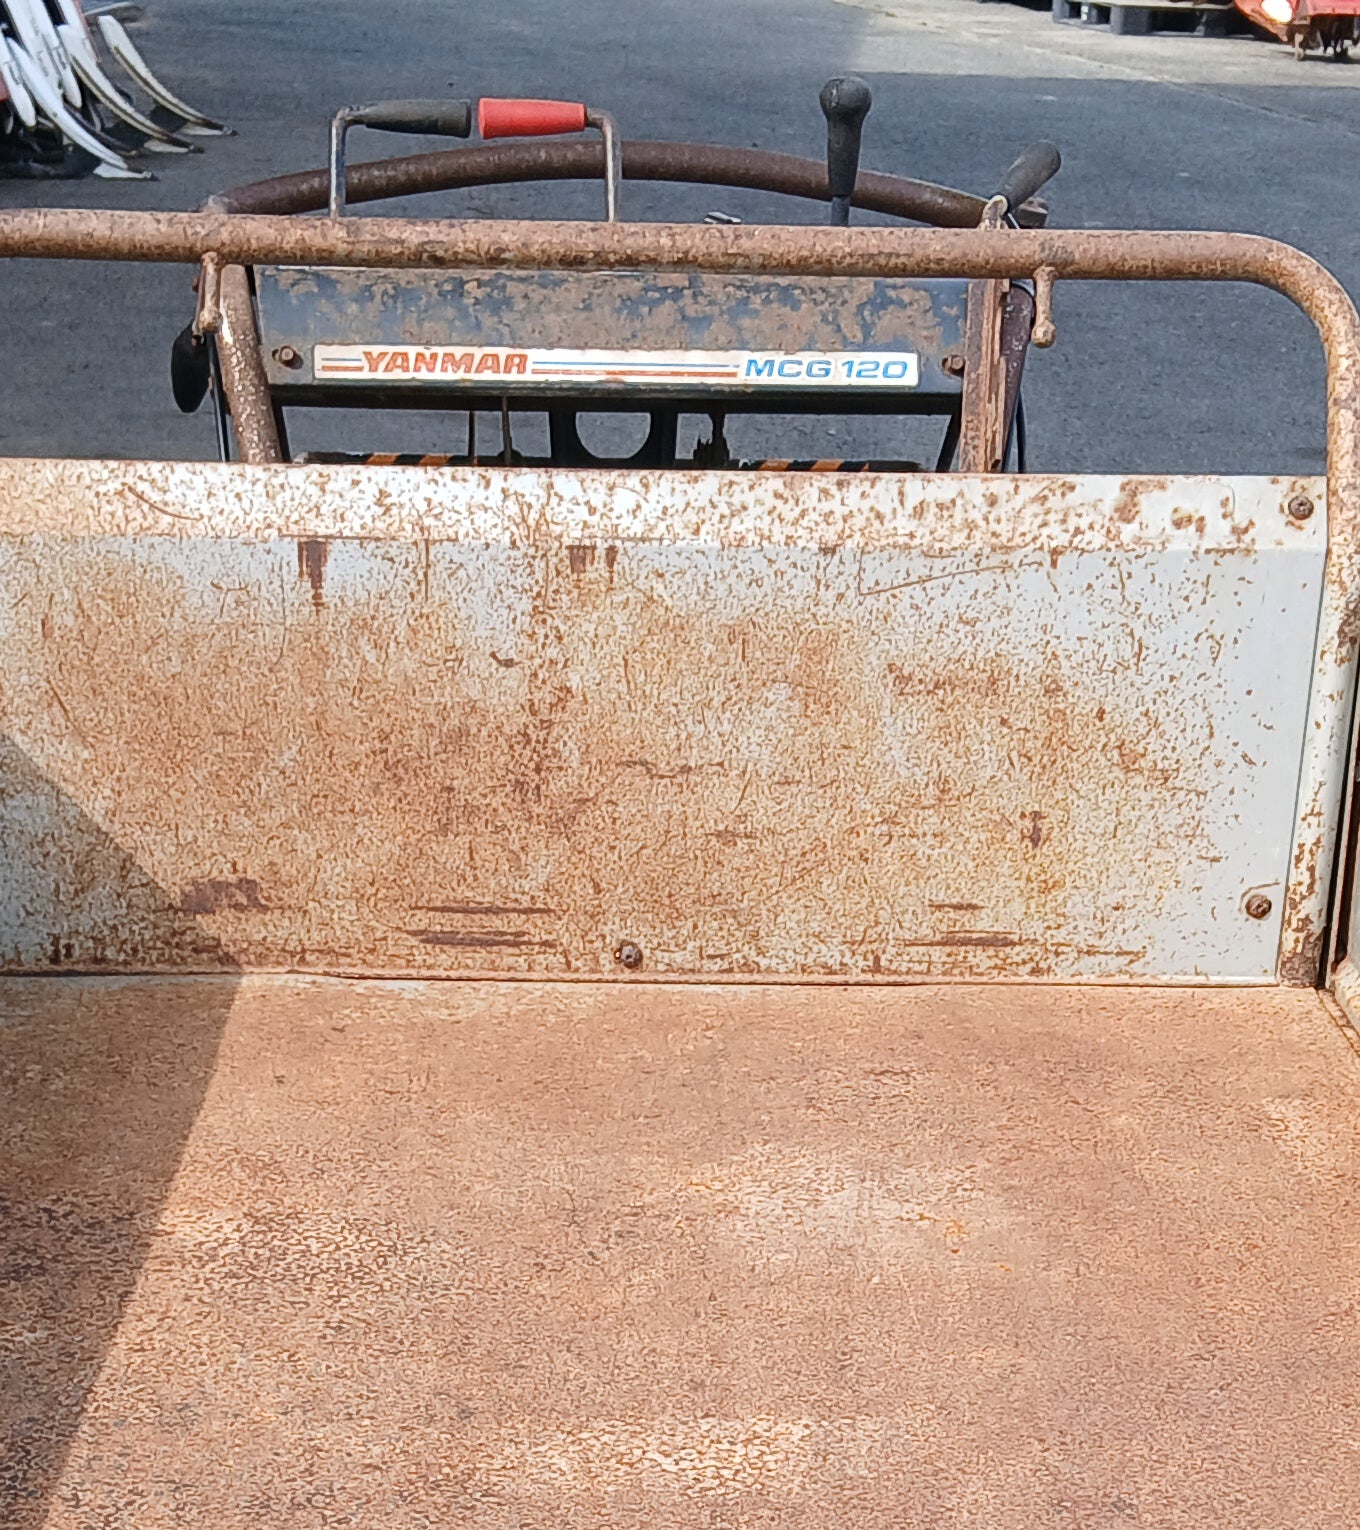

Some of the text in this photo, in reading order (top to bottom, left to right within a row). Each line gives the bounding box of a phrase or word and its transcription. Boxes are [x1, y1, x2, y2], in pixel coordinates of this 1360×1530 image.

[362, 350, 529, 375] YANMAR
[744, 358, 908, 379] MCG 120
